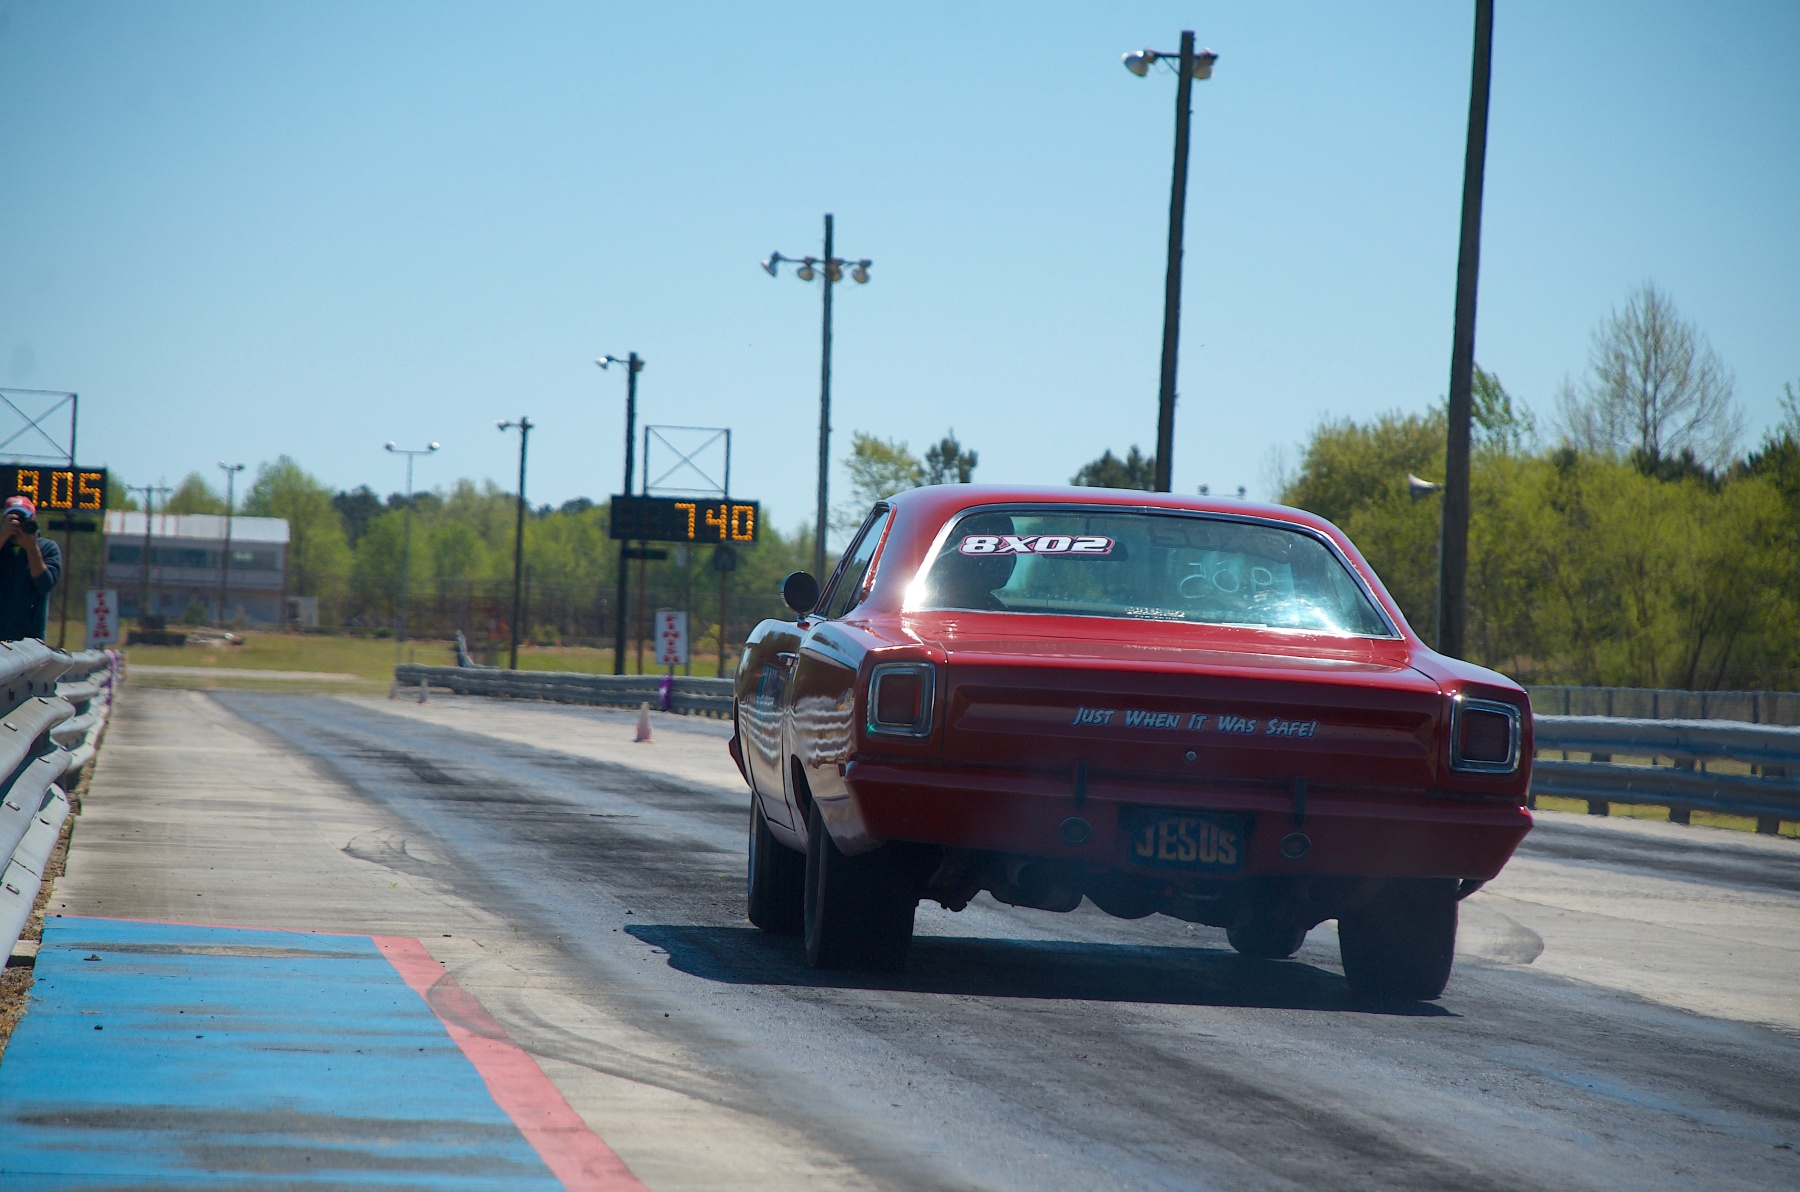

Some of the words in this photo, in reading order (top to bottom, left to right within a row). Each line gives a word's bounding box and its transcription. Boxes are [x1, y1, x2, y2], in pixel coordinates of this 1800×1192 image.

[17, 469, 102, 510] 9.05
[960, 535, 1112, 554] 8X02
[1071, 706, 1116, 727] JUST
[1124, 709, 1181, 729] WHEN
[1188, 713, 1208, 732] IT
[1217, 715, 1258, 734] WAS
[1265, 717, 1318, 738] SAFE!
[1136, 817, 1238, 864] JESUS
